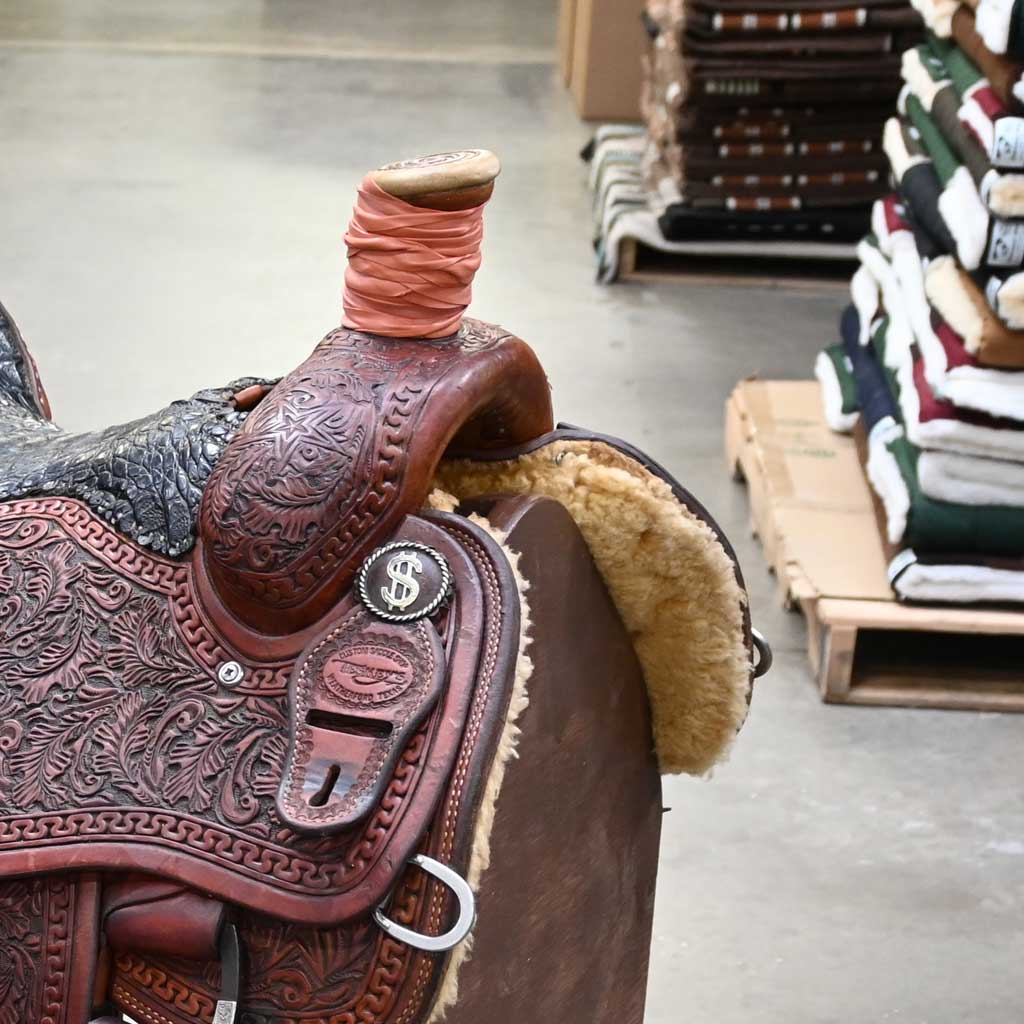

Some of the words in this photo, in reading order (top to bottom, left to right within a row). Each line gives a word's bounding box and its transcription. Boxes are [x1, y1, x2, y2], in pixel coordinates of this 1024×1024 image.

[338, 646, 368, 659] CUSTOM
[326, 672, 373, 701] WEATHERFORD
[376, 685, 403, 700] TEXAS
